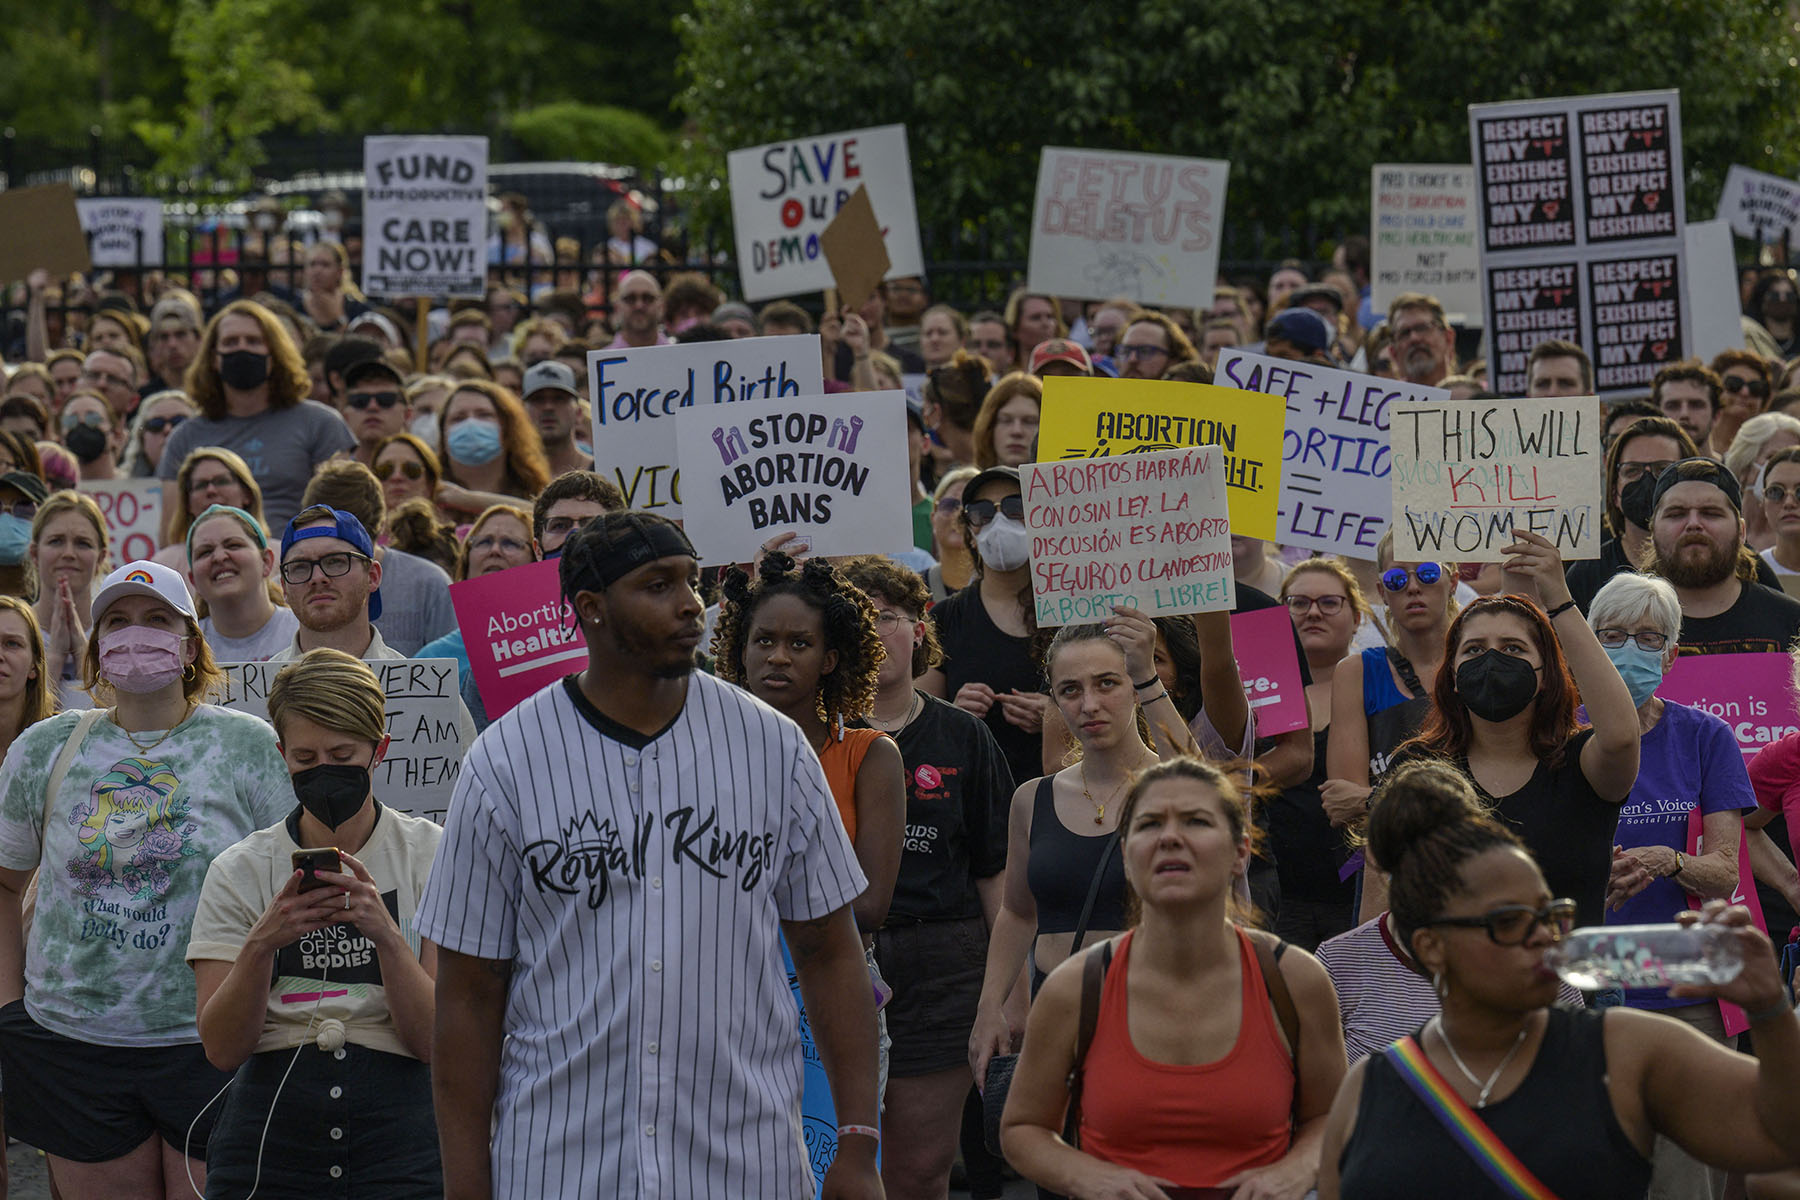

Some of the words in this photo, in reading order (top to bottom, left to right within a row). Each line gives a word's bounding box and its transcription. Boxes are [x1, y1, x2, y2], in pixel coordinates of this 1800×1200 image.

[1483, 116, 1565, 141] RESPECT
[1582, 108, 1664, 133] RESPECT
[1485, 140, 1530, 161] MY
[1585, 131, 1630, 154] MY
[376, 153, 474, 185] FUND
[760, 139, 860, 199] SAVE
[1486, 158, 1566, 183] EXISTENCE
[1587, 150, 1667, 174] EXISTENCE
[1053, 154, 1212, 211] FETUS
[1488, 184, 1509, 204] OR
[1511, 180, 1567, 202] EXPECT
[1588, 176, 1610, 195] OR
[1611, 171, 1667, 193] EXPECT
[1490, 203, 1536, 225] MY
[1590, 194, 1636, 216] MY
[382, 218, 470, 243] CARE
[1041, 197, 1212, 252] DELETUS
[1488, 220, 1573, 246] RESISTANCE
[1588, 212, 1673, 238] RESISTANCE
[379, 248, 475, 272] NOW!
[1592, 258, 1673, 282] RESPECT
[1493, 266, 1575, 290] RESPECT
[1494, 289, 1539, 311] MY
[1594, 282, 1639, 304] MY
[1496, 307, 1576, 331] EXISTENCE
[1596, 300, 1676, 324] EXISTENCE
[1498, 332, 1519, 352] OR
[1598, 325, 1618, 345] OR
[1621, 321, 1676, 342] EXPECT
[1600, 344, 1645, 366] MY
[596, 356, 695, 425] Forced
[713, 360, 800, 404] Birth
[1225, 357, 1312, 412] SAFE
[749, 413, 827, 448] STOP
[1096, 411, 1237, 452] ABORTION
[1397, 407, 1498, 462] THIS
[1513, 407, 1588, 458] WILL
[720, 452, 870, 507] ABORTION
[1028, 462, 1131, 502] ABORTOS
[1136, 451, 1209, 481] HABRÁN
[1448, 464, 1556, 503] KILL
[92, 491, 153, 531] RO-
[748, 493, 833, 530] BANS
[1118, 495, 1152, 519] LEY.
[1161, 492, 1189, 512] LA
[1033, 528, 1121, 559] DISCUSIÓN
[1130, 525, 1156, 544] ES
[1160, 518, 1229, 545] ABORTO
[1405, 508, 1585, 552] WOMEN
[1035, 560, 1116, 597] SEGURO
[1120, 562, 1132, 584] O
[1138, 551, 1231, 582] CLANDESTINO
[1155, 577, 1228, 609] LIBRE!
[491, 624, 577, 662] Health
[1687, 698, 1740, 717] tion
[1748, 696, 1767, 716] is
[412, 715, 459, 744] AM
[382, 757, 460, 787] THEM
[905, 824, 938, 840] KIDS
[1627, 816, 1660, 825] Social
[664, 806, 775, 892] Kings
[84, 898, 120, 916] What
[123, 904, 167, 923] would
[80, 919, 130, 950] Dolly
[133, 923, 171, 950] do?
[300, 940, 335, 954] OFF
[302, 950, 372, 969] BODIES
